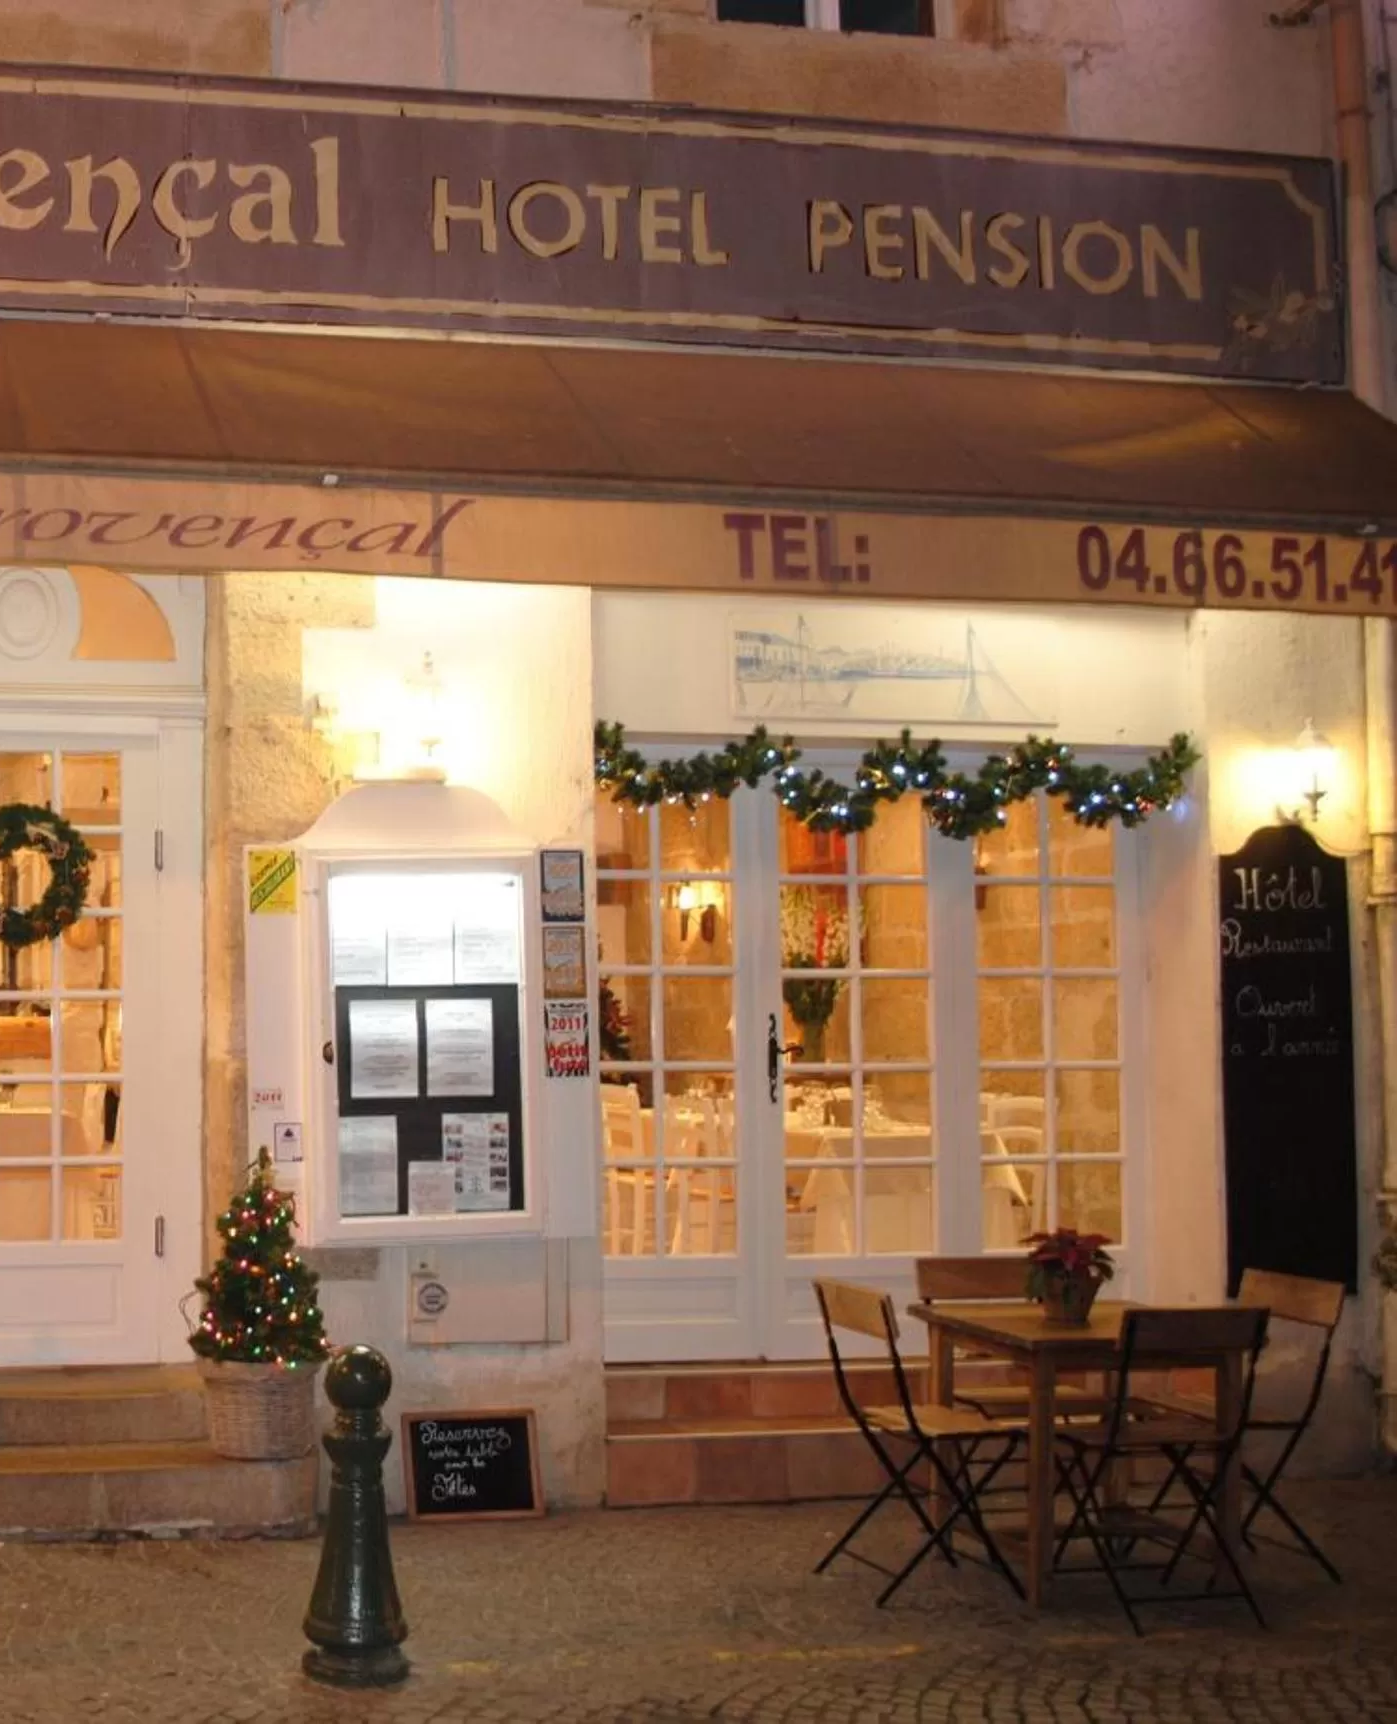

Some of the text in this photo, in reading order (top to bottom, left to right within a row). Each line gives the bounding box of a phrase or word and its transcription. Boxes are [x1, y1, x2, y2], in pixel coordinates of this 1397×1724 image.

[432, 176, 729, 266] HOTEL
[806, 198, 1203, 301] PENSION
[723, 513, 871, 582] TEL:
[1233, 865, 1327, 912] Hôtel
[551, 1016, 582, 1031] 2011
